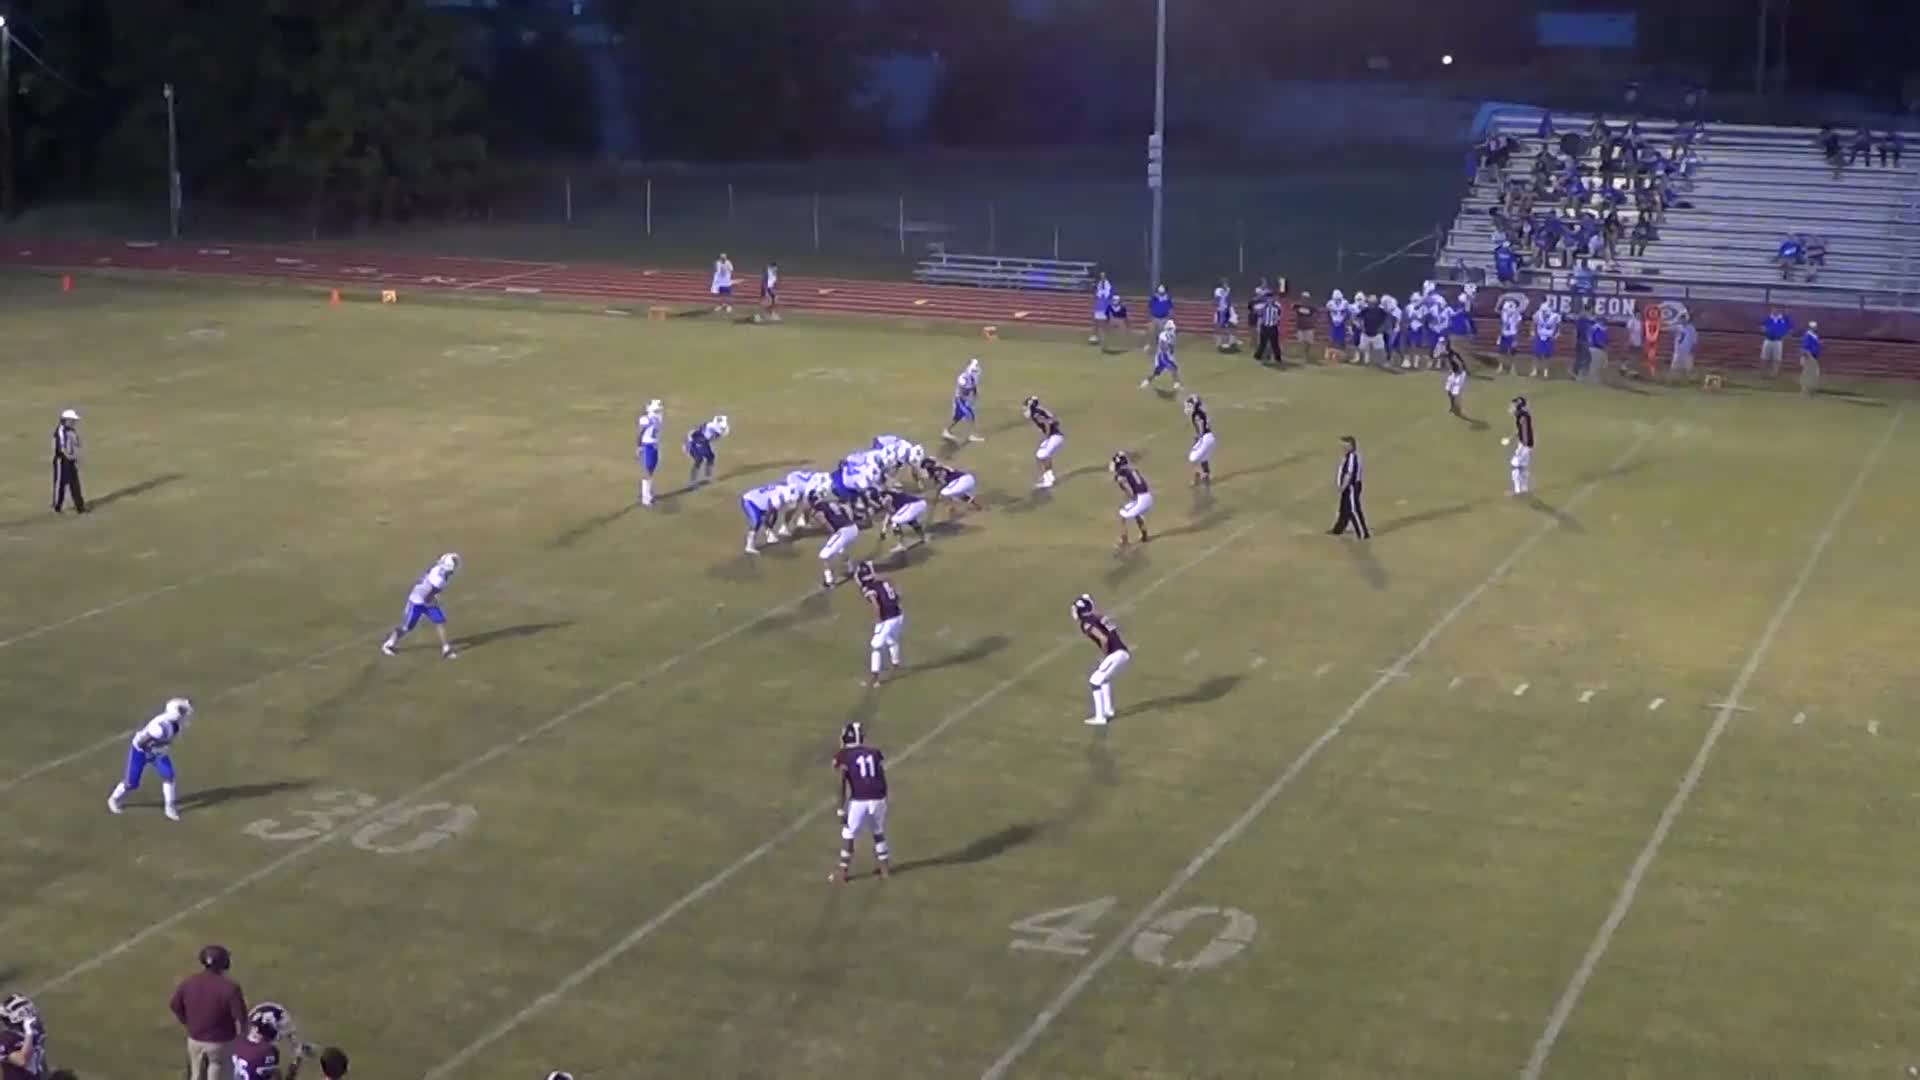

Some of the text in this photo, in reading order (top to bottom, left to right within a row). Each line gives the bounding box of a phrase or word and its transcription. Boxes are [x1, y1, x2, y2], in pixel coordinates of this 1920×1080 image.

[1545, 293, 1573, 314] DE
[855, 754, 876, 778] 11
[243, 788, 477, 854] 30
[1009, 896, 1258, 970] 40
